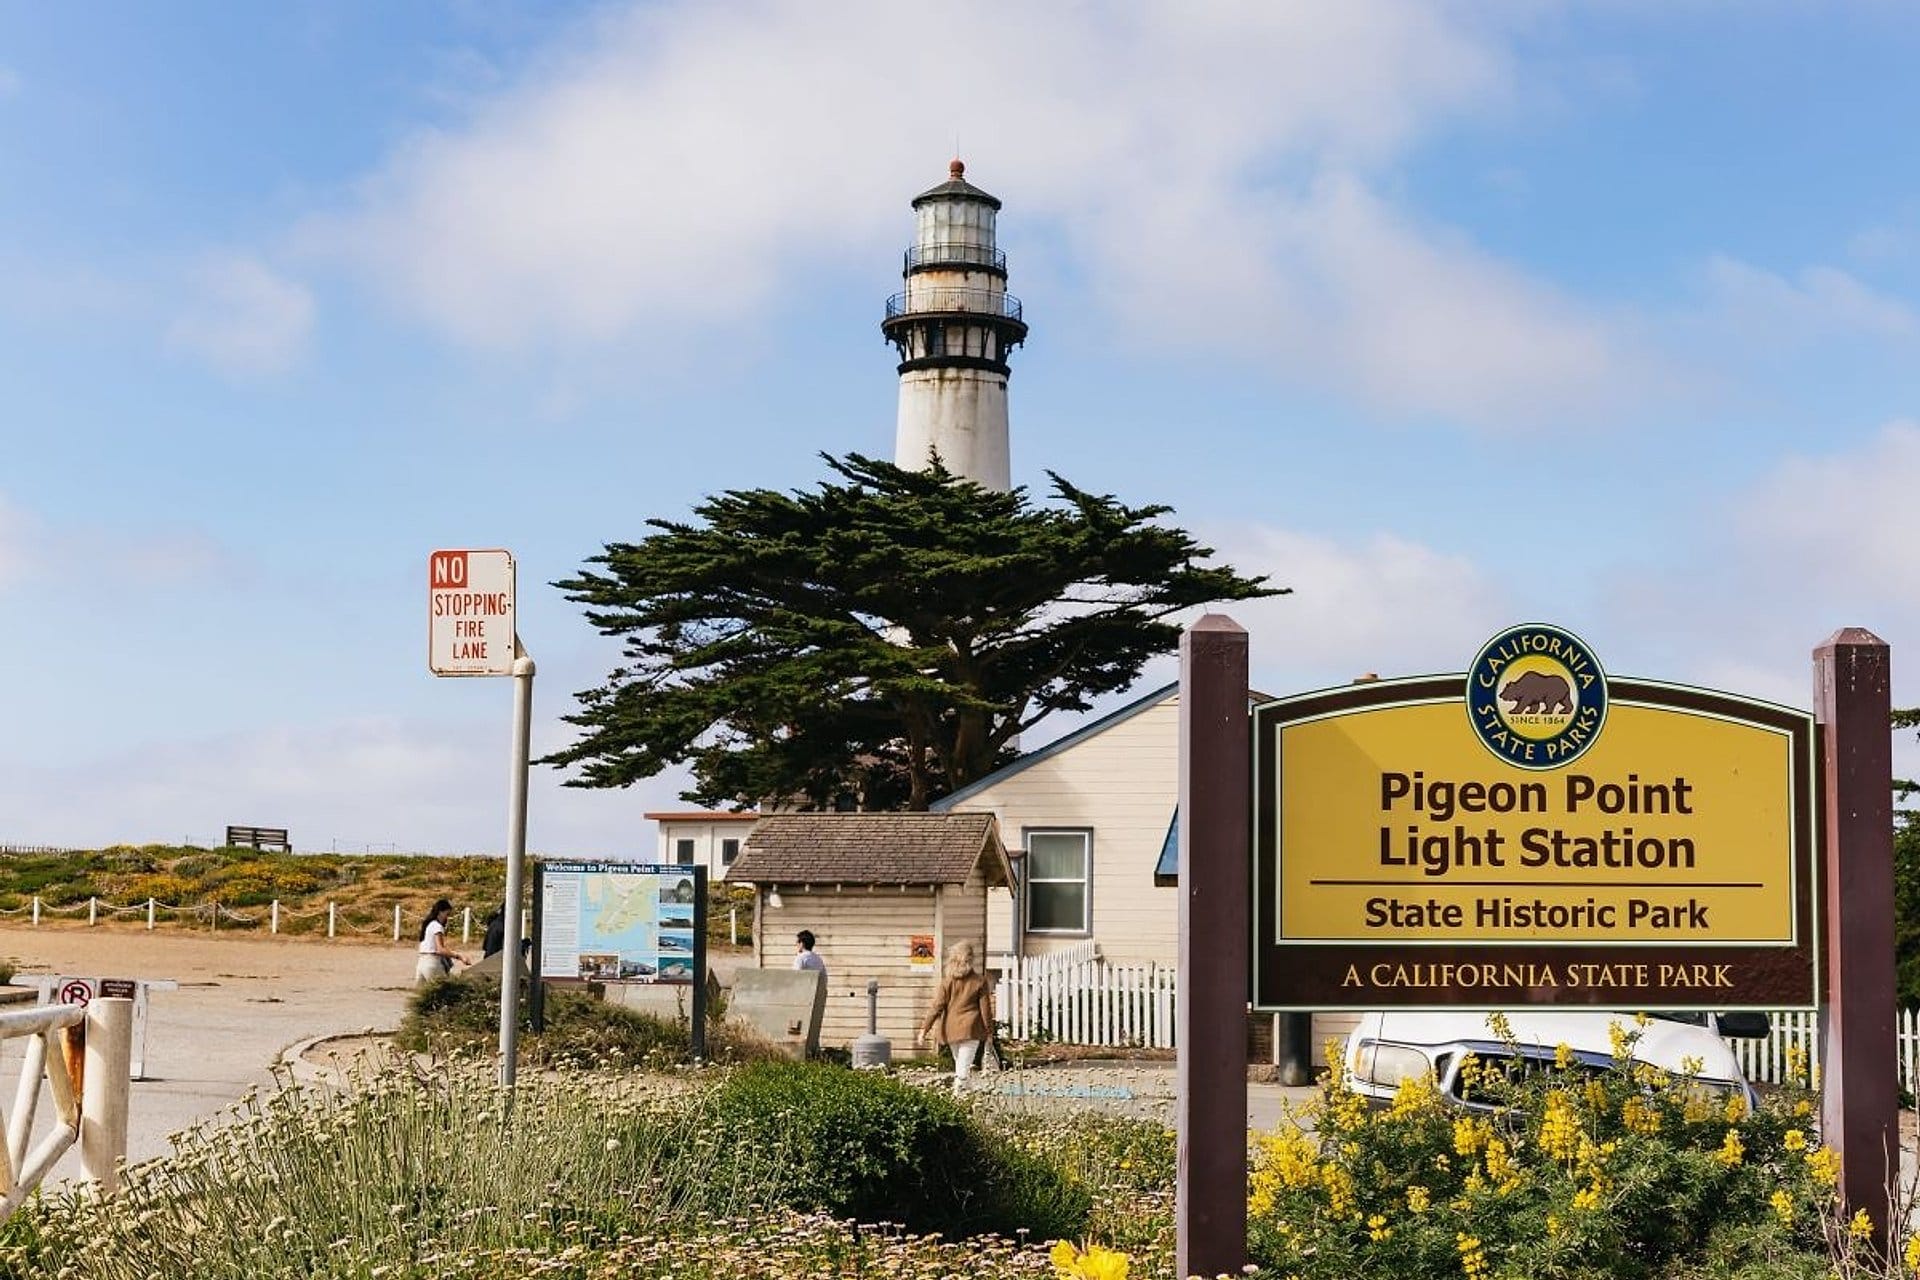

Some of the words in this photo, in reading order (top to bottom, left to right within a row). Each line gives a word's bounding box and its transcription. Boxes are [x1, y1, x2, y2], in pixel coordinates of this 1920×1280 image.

[435, 556, 464, 584] NO
[435, 593, 507, 616] STOPPING
[456, 620, 485, 637] FIRE
[453, 642, 488, 659] LANE
[1479, 634, 1596, 689] CALIFORNIA
[1478, 703, 1536, 760] STATE
[1546, 705, 1598, 759] PARKS
[1510, 716, 1540, 724] SINCE
[1381, 772, 1547, 821] Pigeon
[1566, 774, 1693, 814] Point
[1380, 826, 1505, 876] Light
[1520, 828, 1695, 868] Station
[545, 863, 585, 872] Welcome
[587, 864, 597, 872] to
[598, 864, 629, 874] Pigeon
[631, 865, 655, 873] Point
[1365, 898, 1463, 928] State
[1476, 898, 1616, 929] Historic
[1628, 899, 1709, 929] Park
[1342, 964, 1364, 986] A
[1371, 963, 1559, 987] CALIFORNIA
[1566, 964, 1649, 987] STATE
[1658, 964, 1734, 987] PARK
